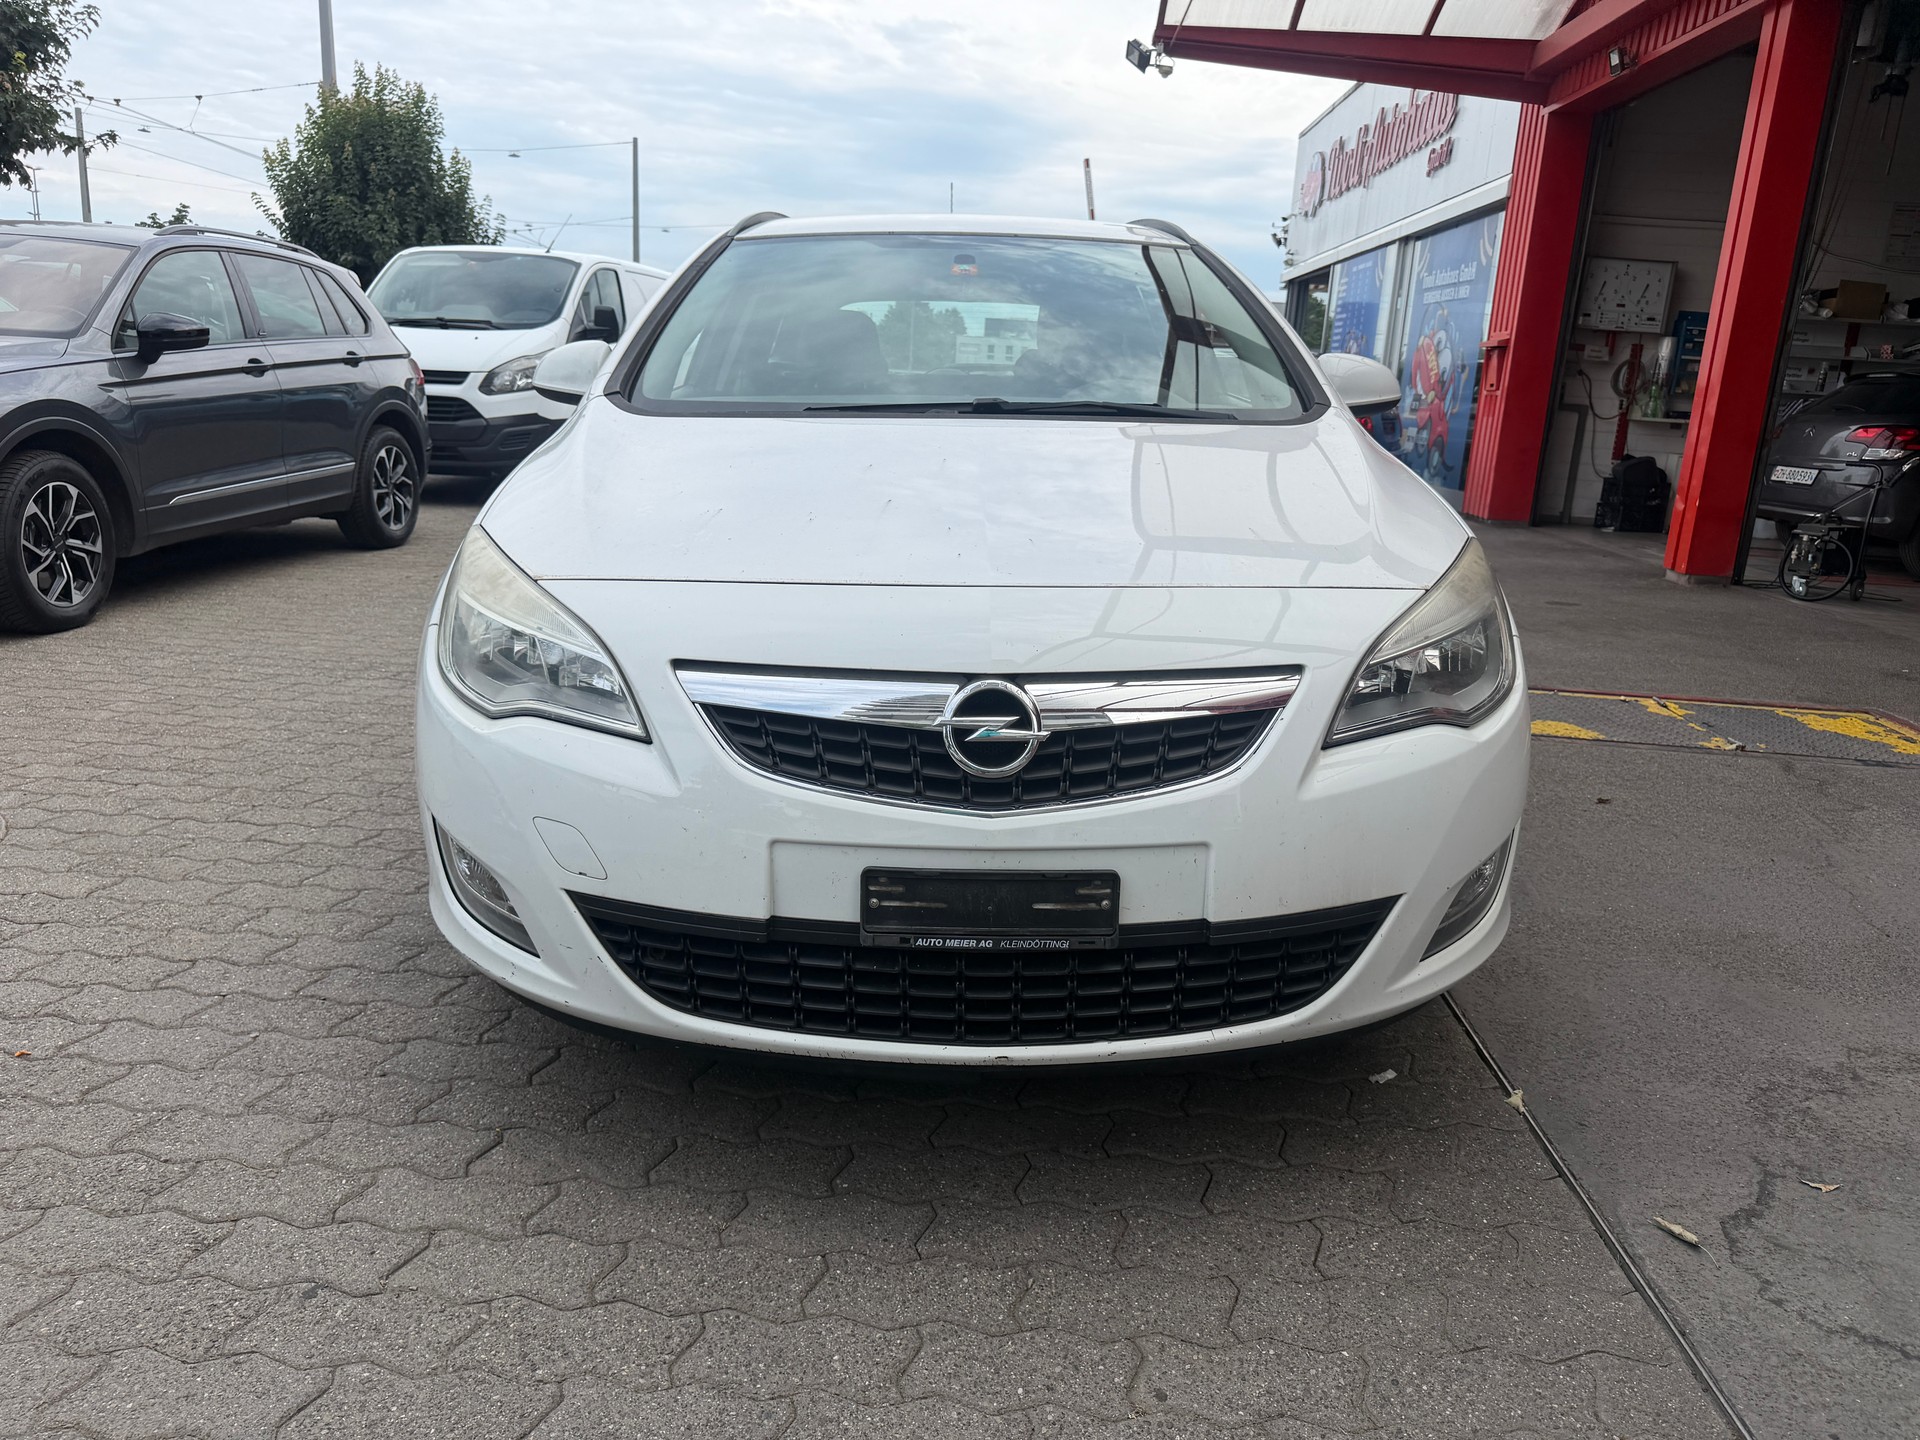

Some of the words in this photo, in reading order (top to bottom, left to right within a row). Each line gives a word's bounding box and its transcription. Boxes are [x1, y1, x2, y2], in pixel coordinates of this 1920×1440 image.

[915, 938, 943, 947] AUTO
[945, 938, 977, 948] MEIER
[978, 939, 993, 948] AG
